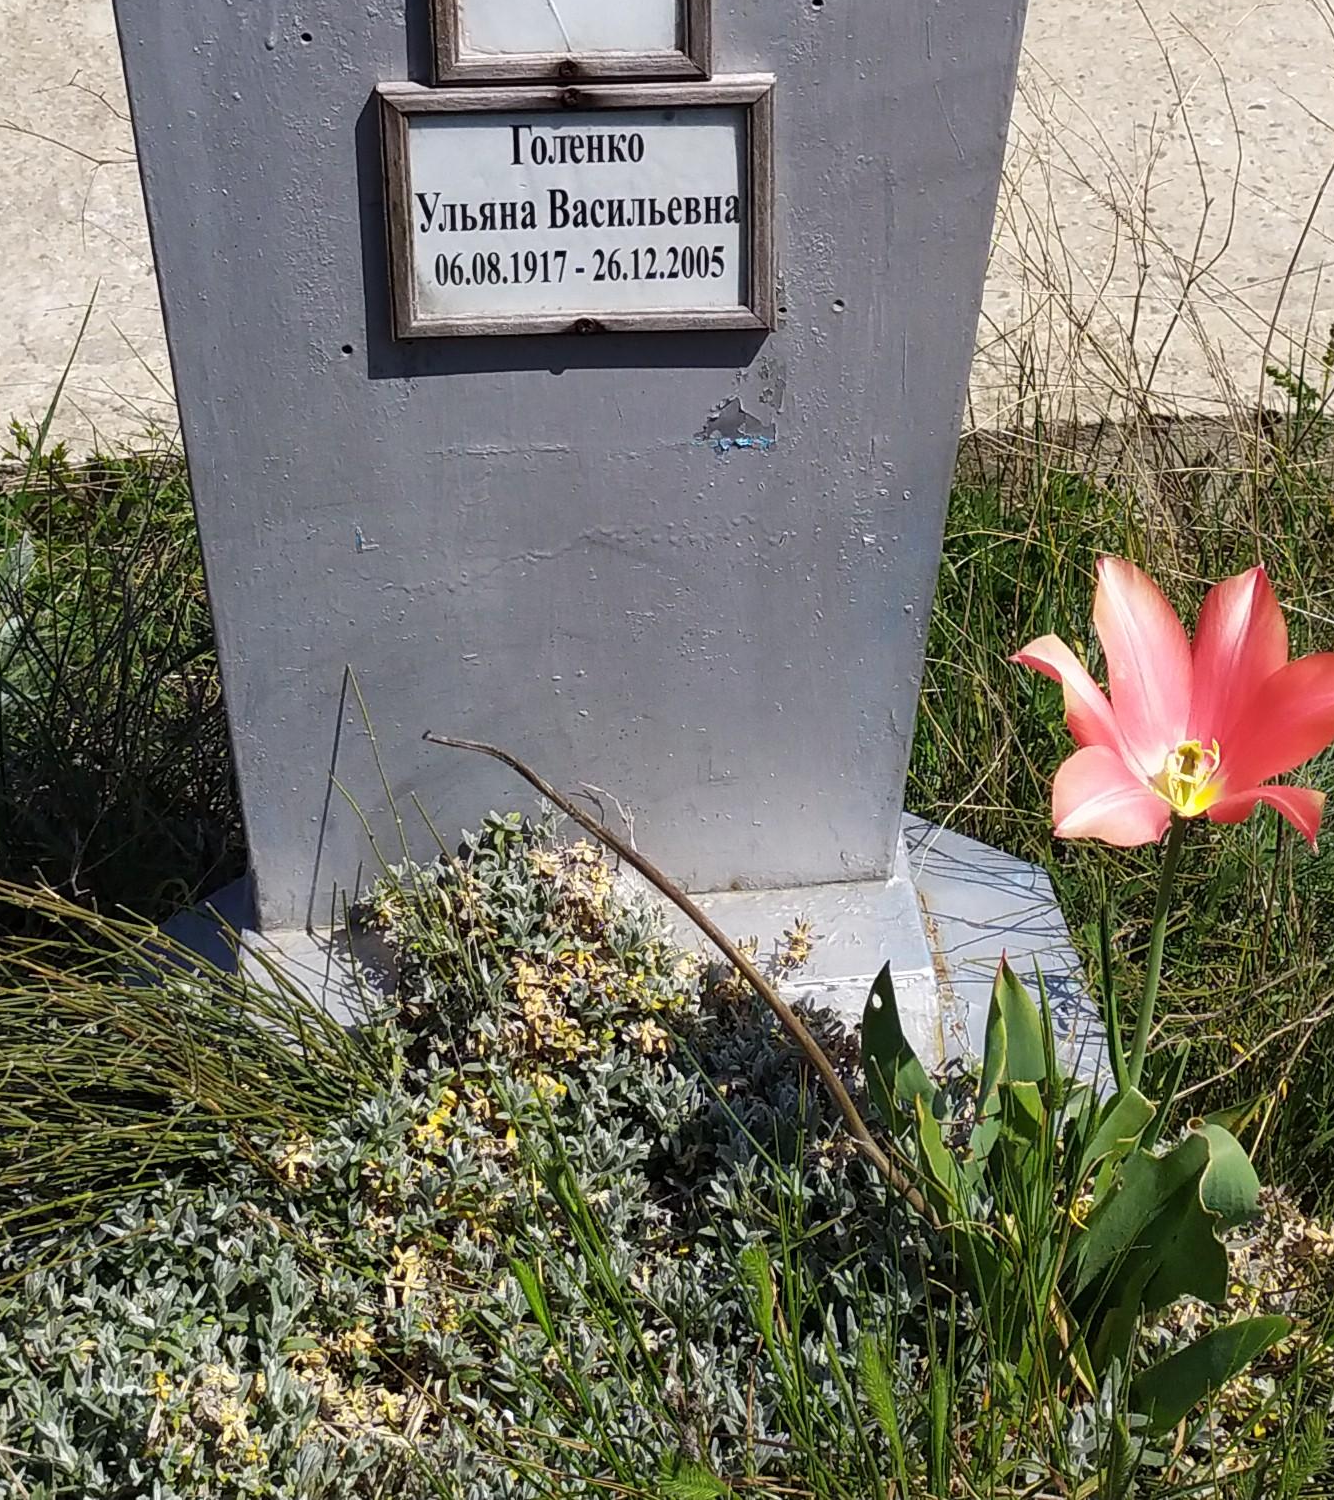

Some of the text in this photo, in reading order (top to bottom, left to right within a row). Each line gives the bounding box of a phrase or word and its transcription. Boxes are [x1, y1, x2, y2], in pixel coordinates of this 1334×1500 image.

[509, 124, 645, 166] Голенко
[414, 188, 742, 233] Ульяна Васильевна
[434, 250, 568, 287] 06.08.1917
[592, 245, 726, 282] 26.12.2005
